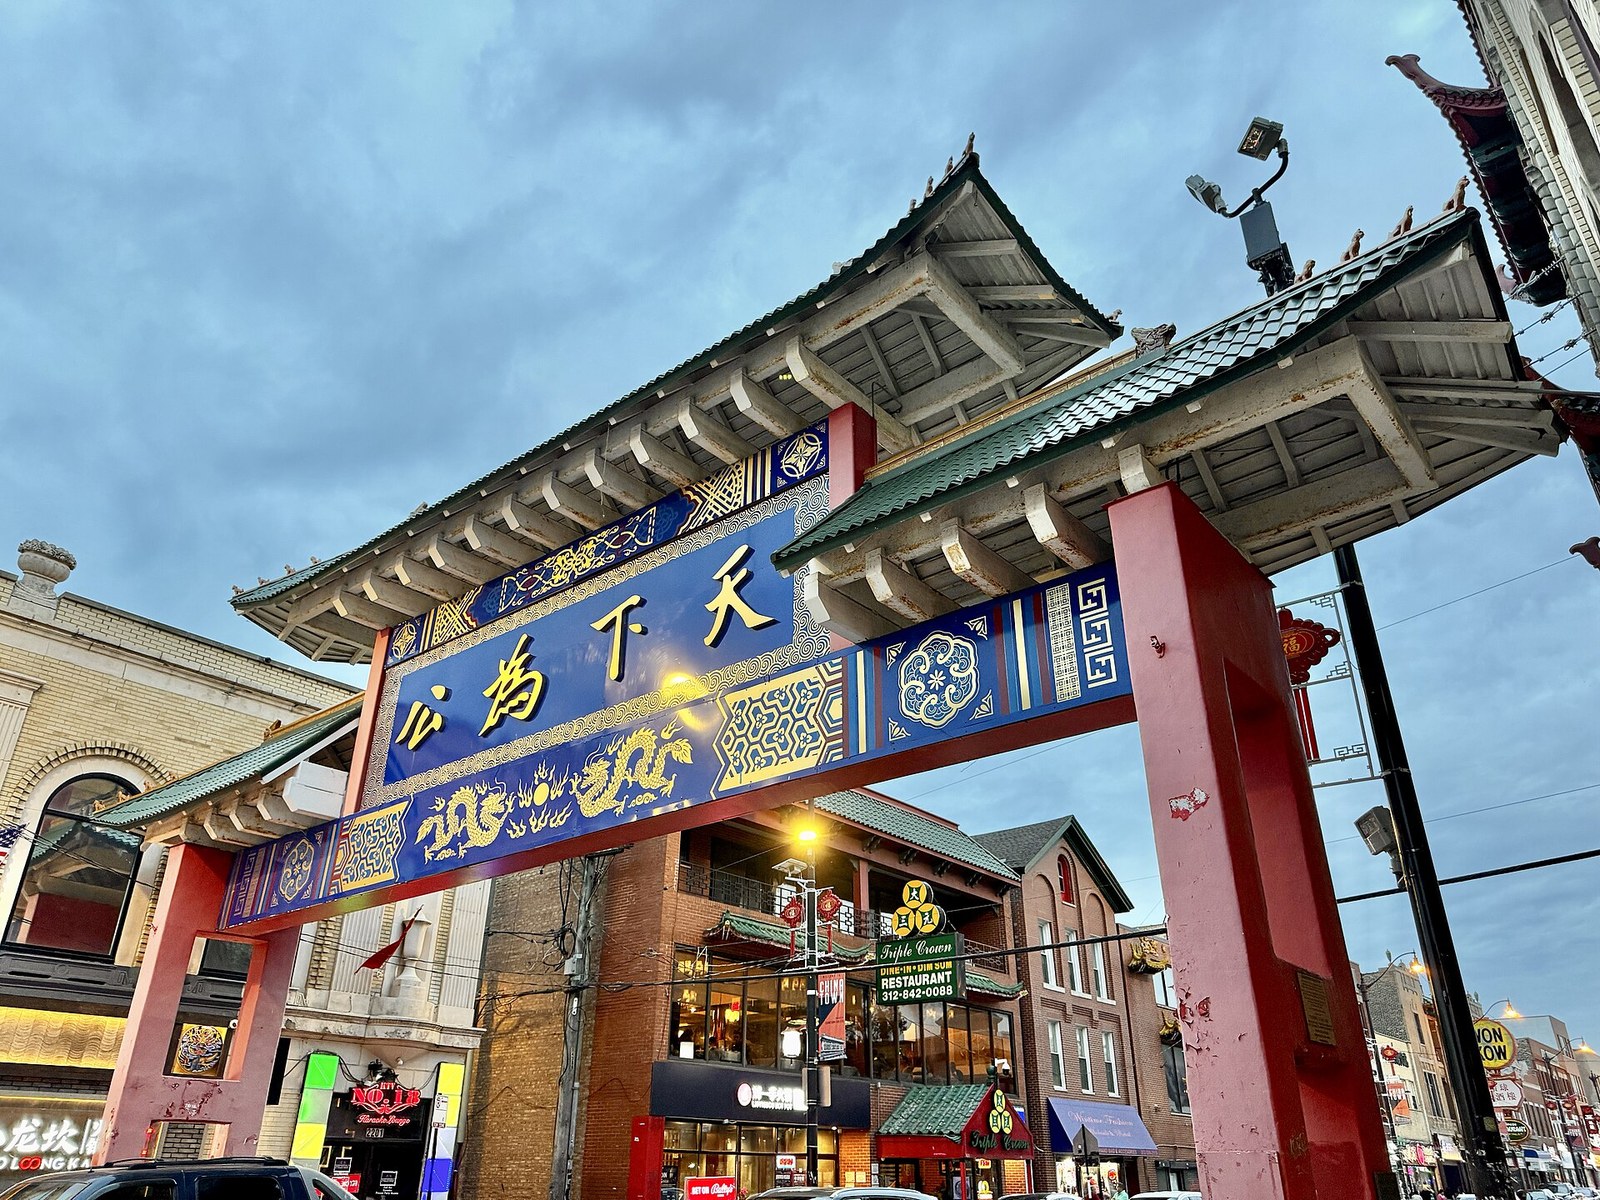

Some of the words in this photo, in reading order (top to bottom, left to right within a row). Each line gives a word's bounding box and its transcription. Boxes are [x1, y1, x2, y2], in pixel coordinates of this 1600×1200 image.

[909, 887, 920, 901] 大
[880, 942, 913, 964] Triple
[915, 939, 953, 956] Crown
[917, 963, 934, 973] DIM
[934, 961, 953, 970] SUM
[819, 978, 844, 994] CHINA
[881, 970, 953, 990] RESTAURANT
[819, 991, 844, 1006] TOWN
[882, 985, 953, 1001] 312-842-0088
[971, 1130, 998, 1154] Triple
[1003, 1135, 1030, 1151] Crown
